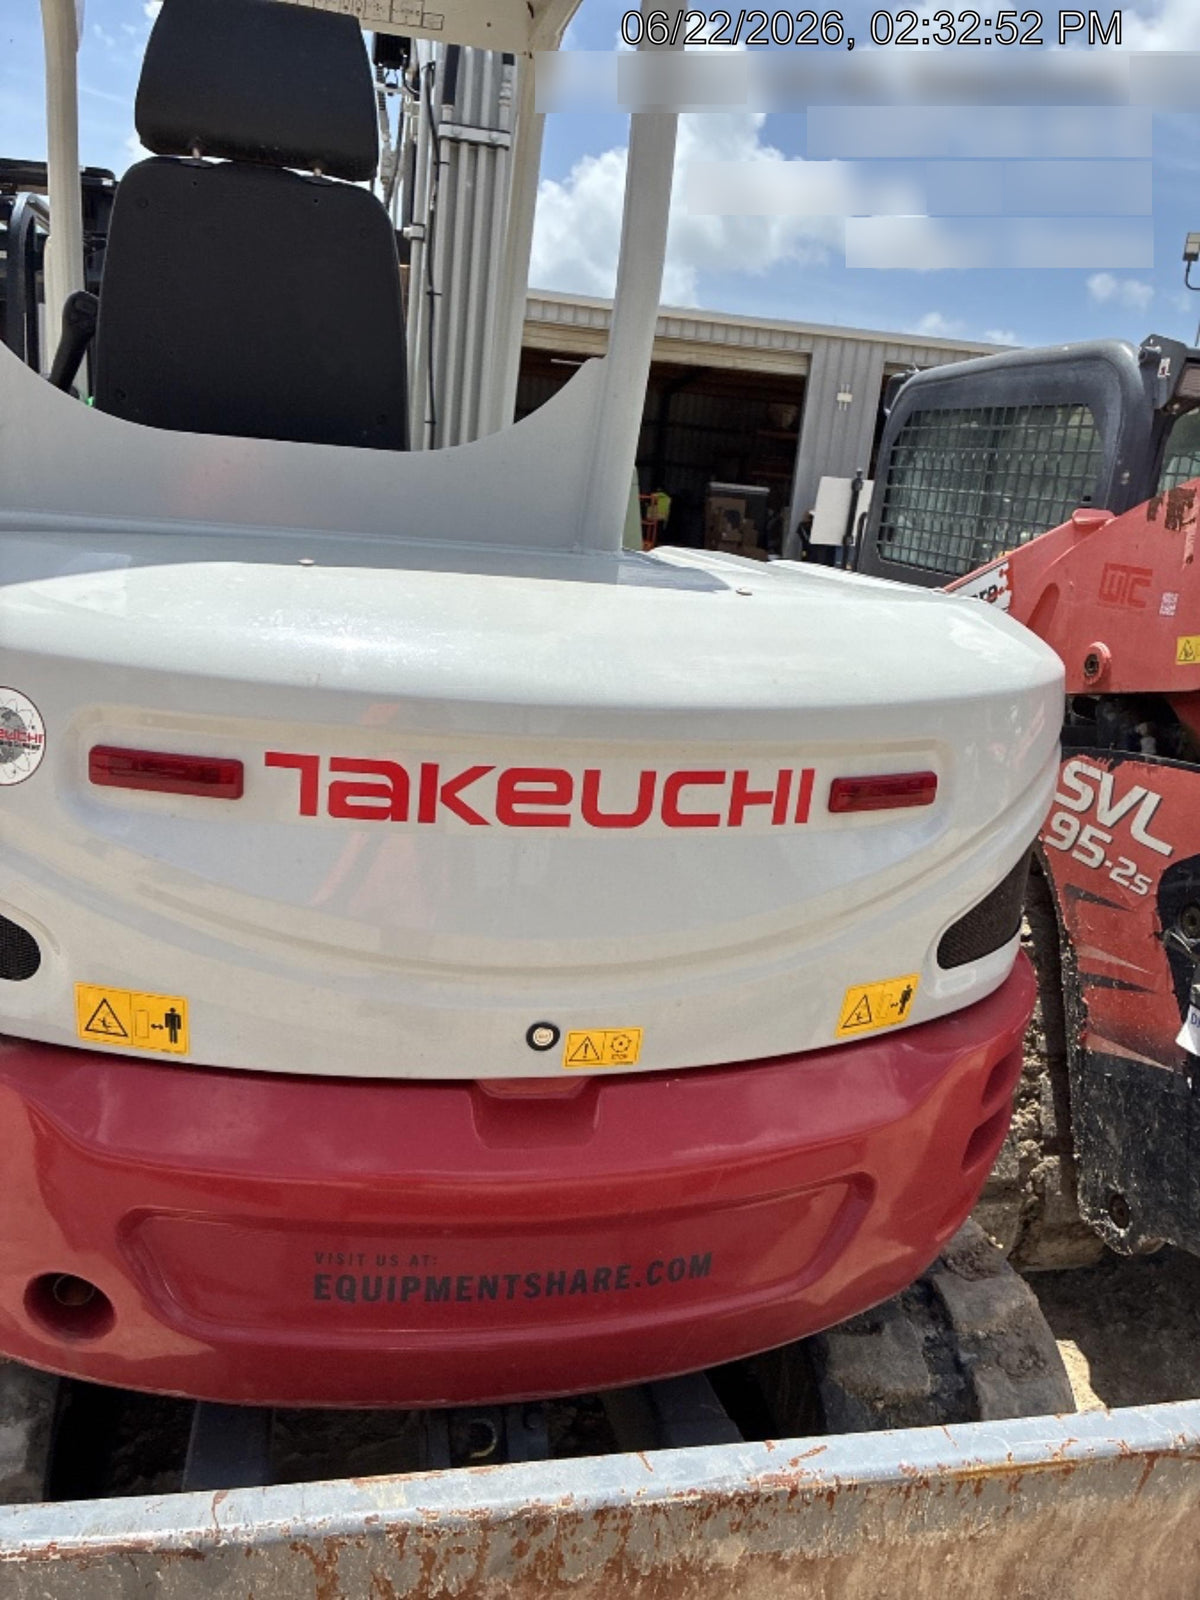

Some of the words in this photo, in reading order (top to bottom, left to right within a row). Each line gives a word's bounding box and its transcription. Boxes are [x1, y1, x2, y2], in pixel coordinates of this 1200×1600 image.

[1054, 760, 1174, 858] SVL
[313, 1251, 713, 1304] EQUIPMENTSHARE.COM
[314, 1252, 366, 1267] VISIT
[376, 1254, 399, 1267] US
[409, 1254, 438, 1267] AT:
